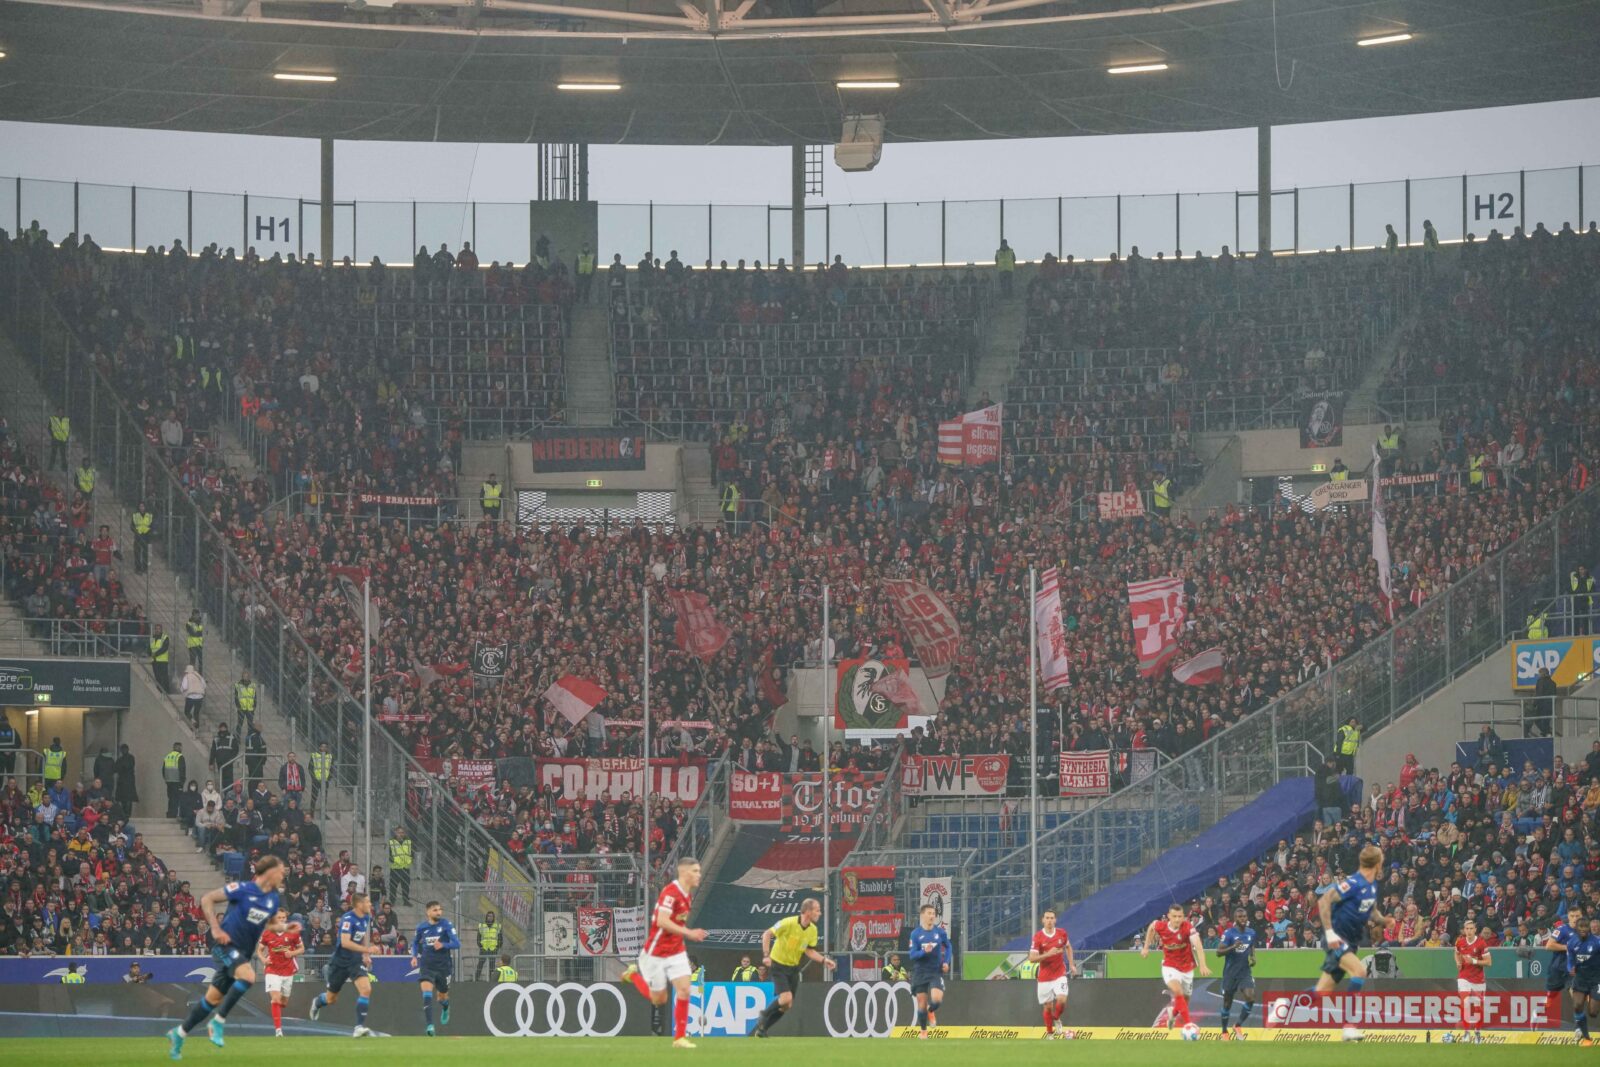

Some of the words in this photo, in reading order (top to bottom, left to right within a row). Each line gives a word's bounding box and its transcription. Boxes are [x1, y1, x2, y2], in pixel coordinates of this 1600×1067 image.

[1474, 192, 1514, 220] H2
[255, 215, 290, 243] H1
[1517, 649, 1560, 678] SAP
[33, 683, 54, 691] Arena
[1060, 759, 1108, 774] SYNTHESIA
[542, 763, 700, 801] CORRILLO
[923, 759, 975, 792] IWF
[1061, 774, 1094, 787] ULTRAS
[793, 814, 809, 827] 19
[810, 811, 872, 828] Feiburg
[769, 889, 797, 899] ist
[868, 919, 892, 935] Ortenau
[673, 983, 767, 1035] SAP
[901, 1027, 949, 1040] interetten
[970, 1027, 1019, 1040] interwetten
[1116, 1028, 1169, 1040] interwetten
[1274, 1029, 1331, 1041] interwetten
